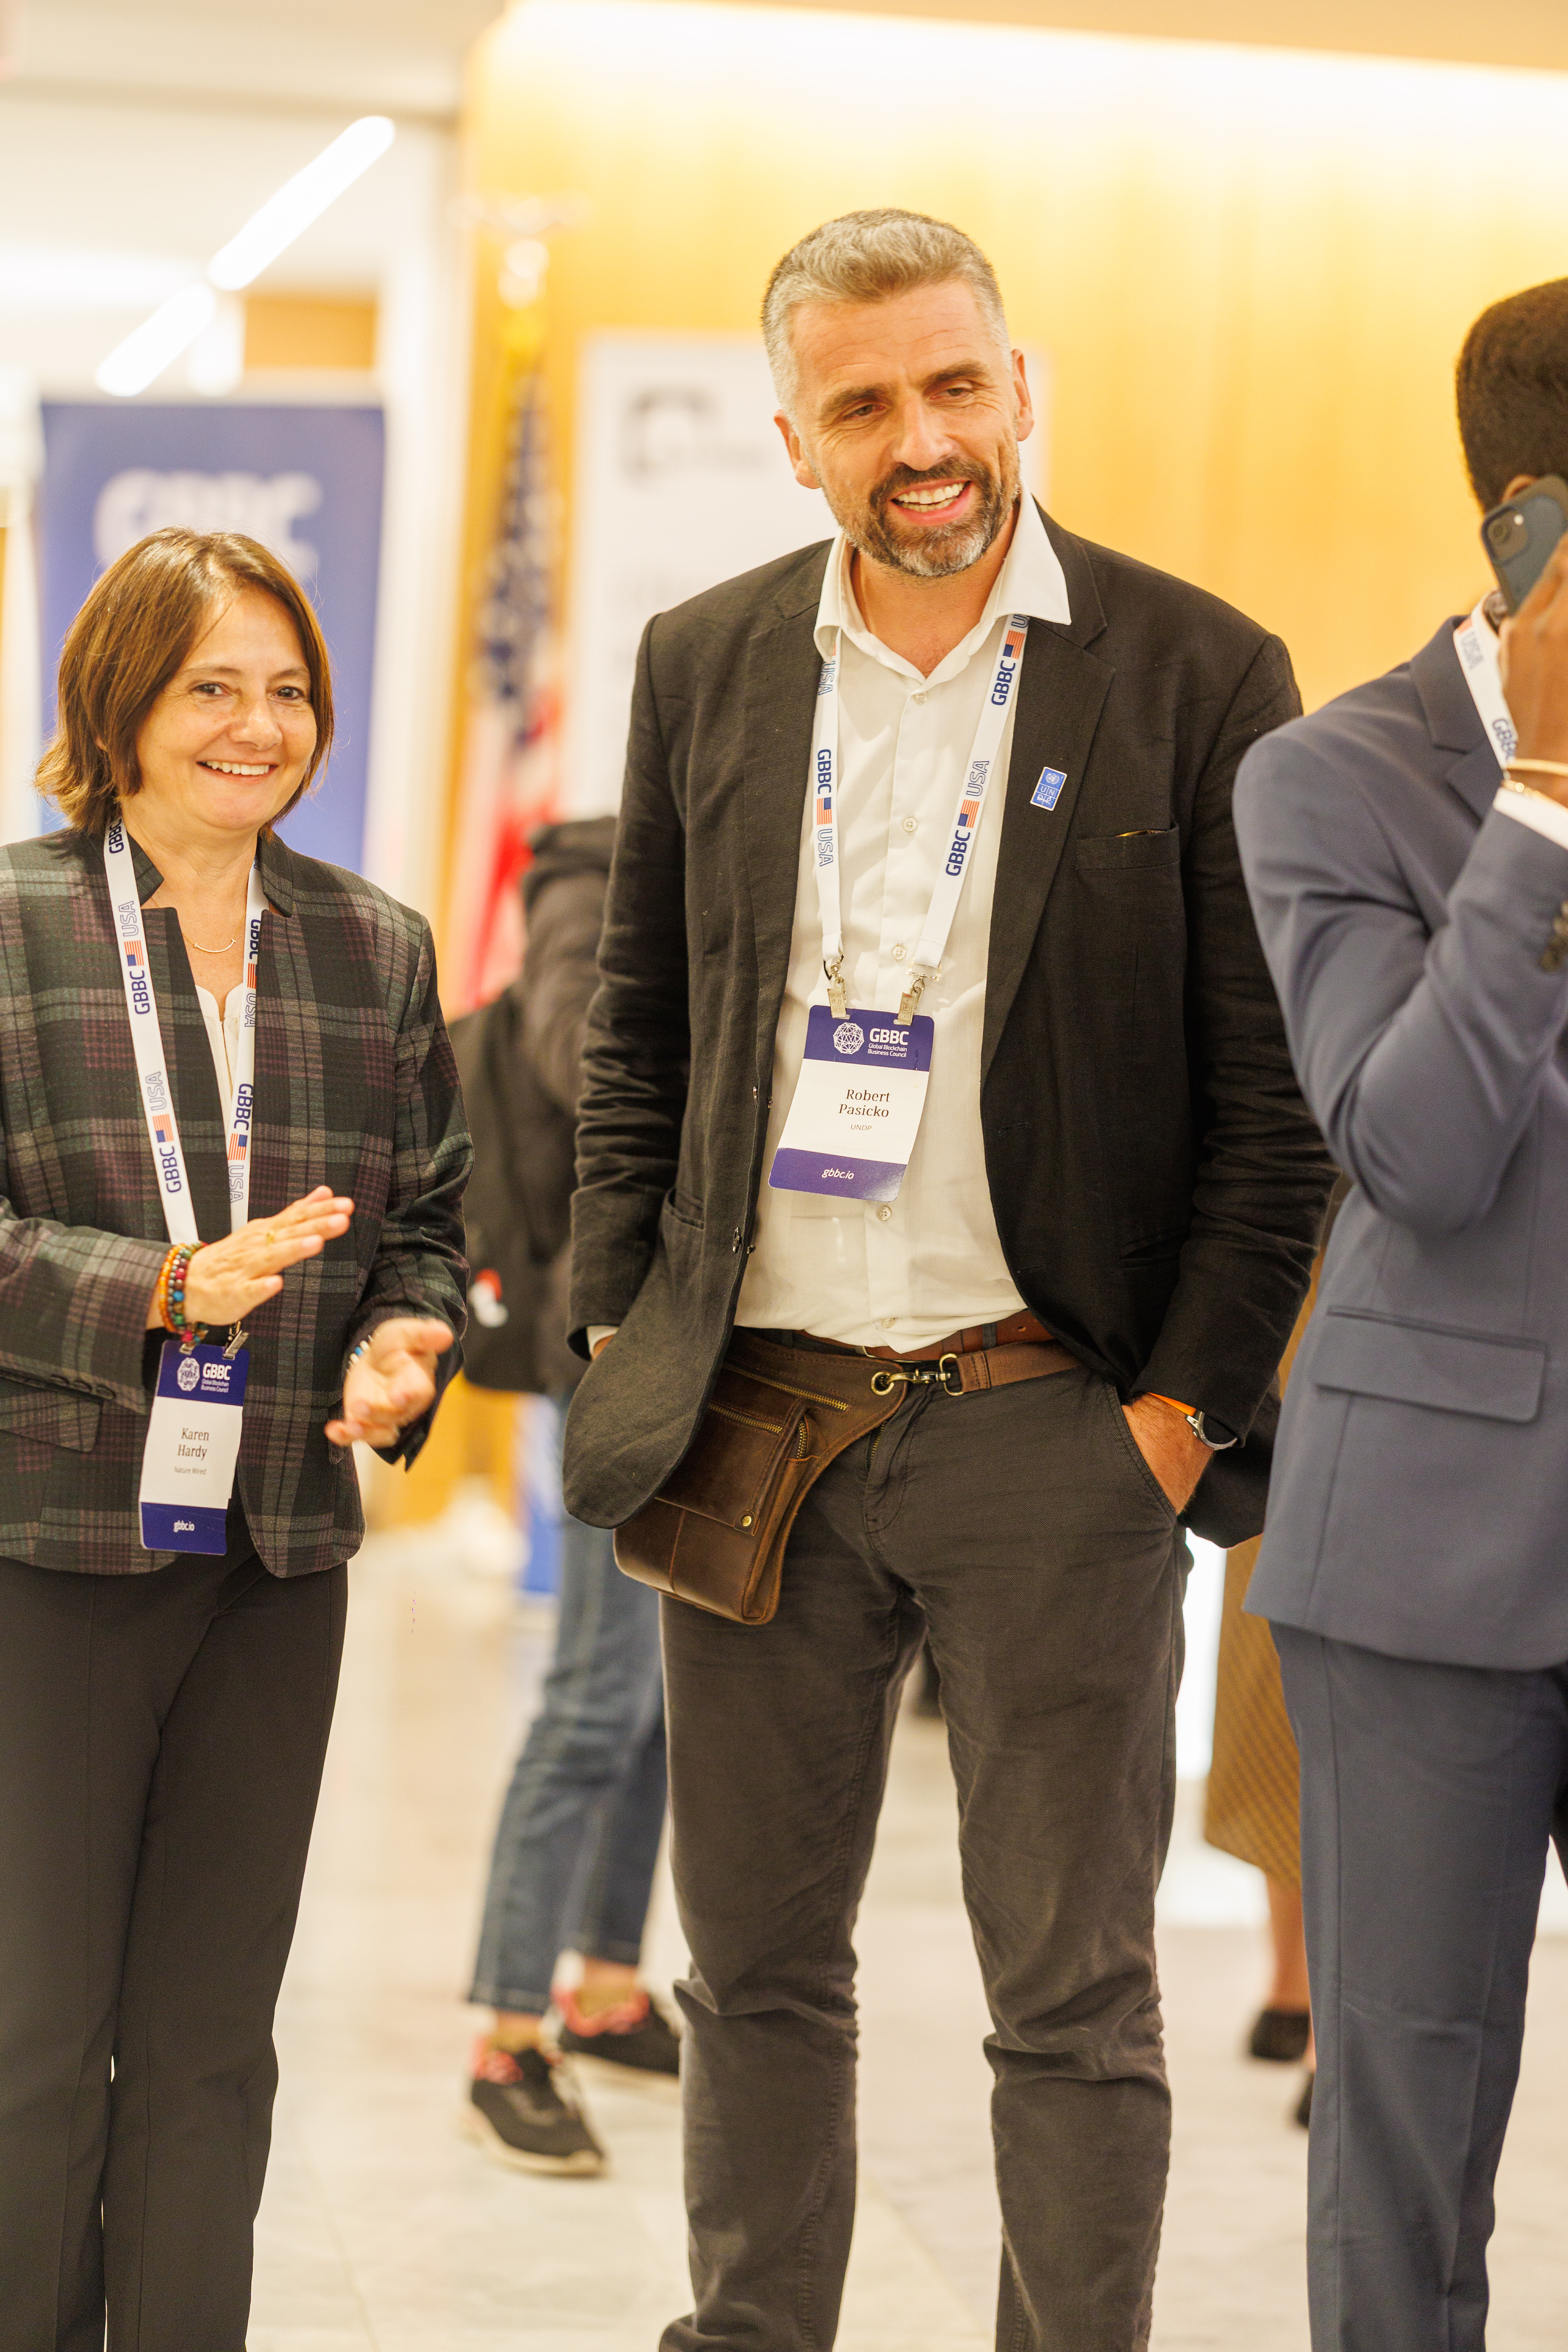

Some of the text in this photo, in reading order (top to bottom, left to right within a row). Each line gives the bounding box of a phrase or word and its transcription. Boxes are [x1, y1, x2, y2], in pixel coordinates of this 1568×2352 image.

[818, 660, 835, 695] USA
[991, 660, 1016, 706] GBBC
[817, 749, 833, 867] GBBC USA
[946, 760, 990, 877] GBBC USA
[109, 818, 124, 853] GBBC
[118, 900, 150, 1014] GBBC USA
[245, 993, 257, 1027] USA
[869, 1028, 909, 1045] GBBC
[838, 1103, 889, 1117] Pasicko
[845, 1089, 891, 1102] Robert
[145, 1071, 182, 1193] GBBC USA
[229, 1083, 254, 1203] GBBC USA
[821, 1167, 855, 1180] gbbc.io
[202, 1362, 232, 1381] GBBC
[181, 1428, 209, 1441] Karen
[178, 1444, 207, 1461] Hardy
[173, 1520, 195, 1533] gbbc.io
